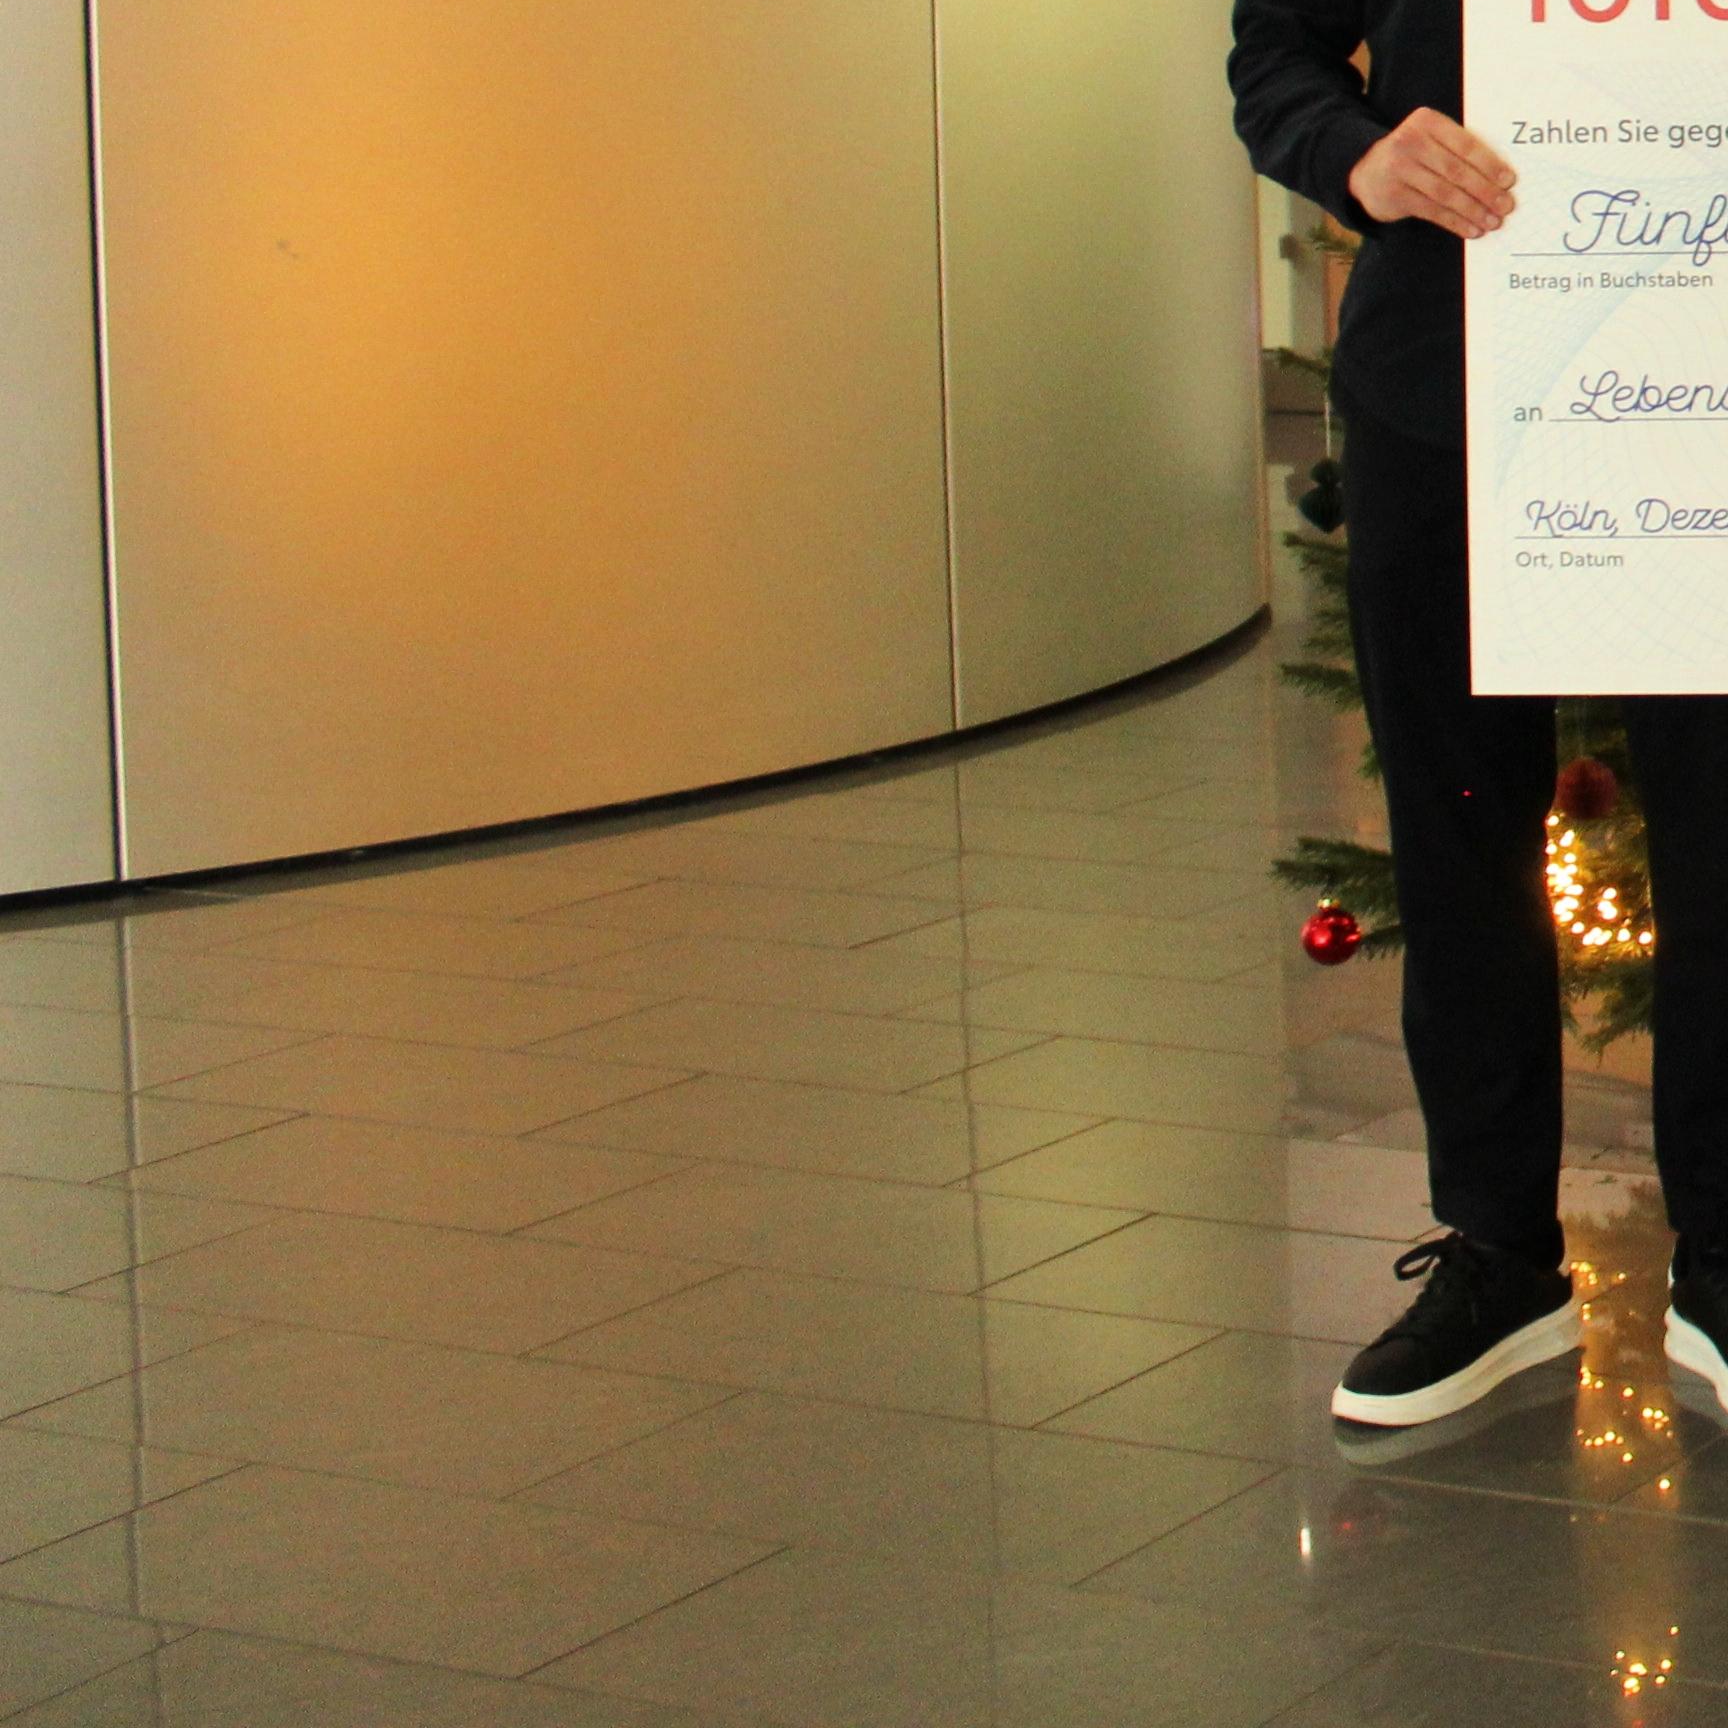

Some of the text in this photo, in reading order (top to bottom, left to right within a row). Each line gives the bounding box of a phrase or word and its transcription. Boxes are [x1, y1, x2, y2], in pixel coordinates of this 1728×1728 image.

[1512, 120, 1607, 144] Zahlen
[1618, 120, 1659, 143] Sie
[1510, 271, 1713, 292] Betrag in Buchstaben
[1514, 407, 1543, 421] an
[1526, 500, 1619, 537] Köln,
[1516, 551, 1623, 569] Ort, Datum
